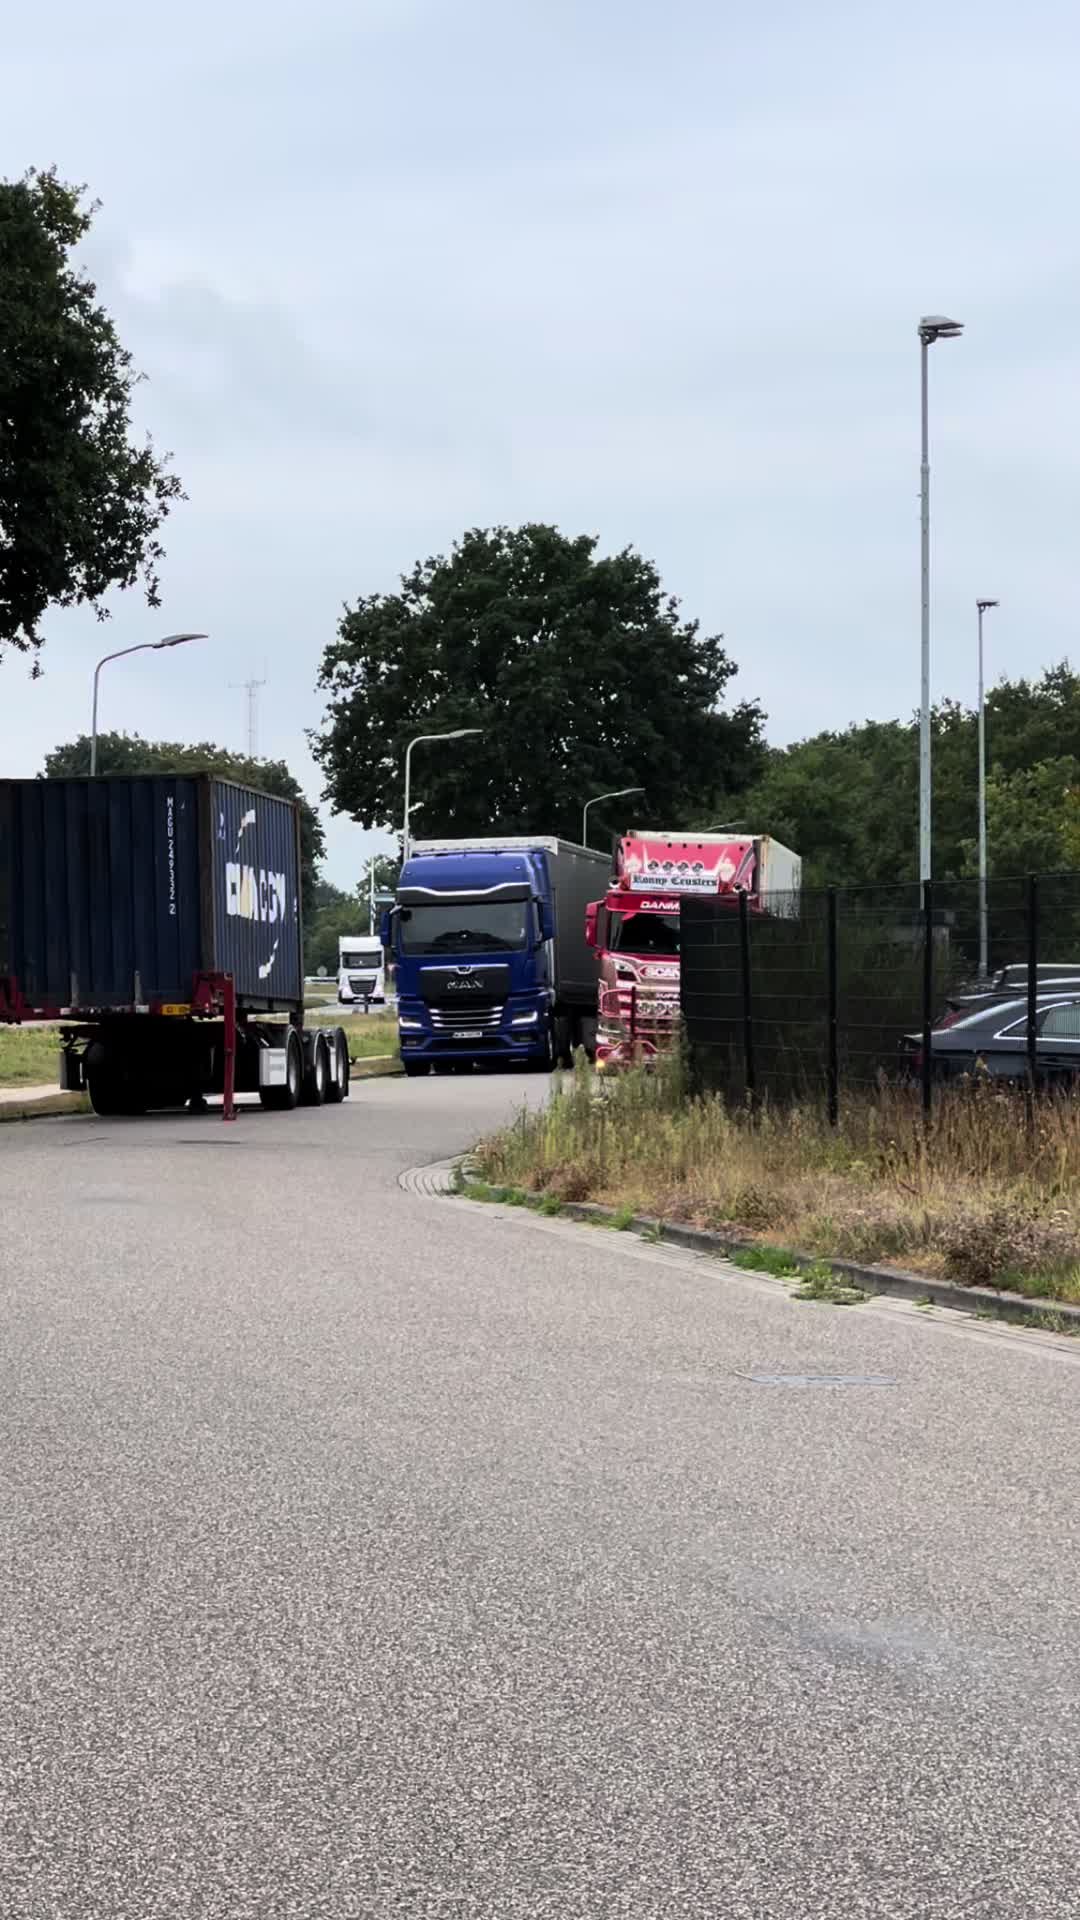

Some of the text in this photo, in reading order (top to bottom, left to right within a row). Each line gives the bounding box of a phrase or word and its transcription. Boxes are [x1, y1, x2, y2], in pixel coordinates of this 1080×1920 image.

[640, 901, 680, 910] DANM
[643, 966, 680, 978] SCAN
[447, 980, 483, 990] MAN
